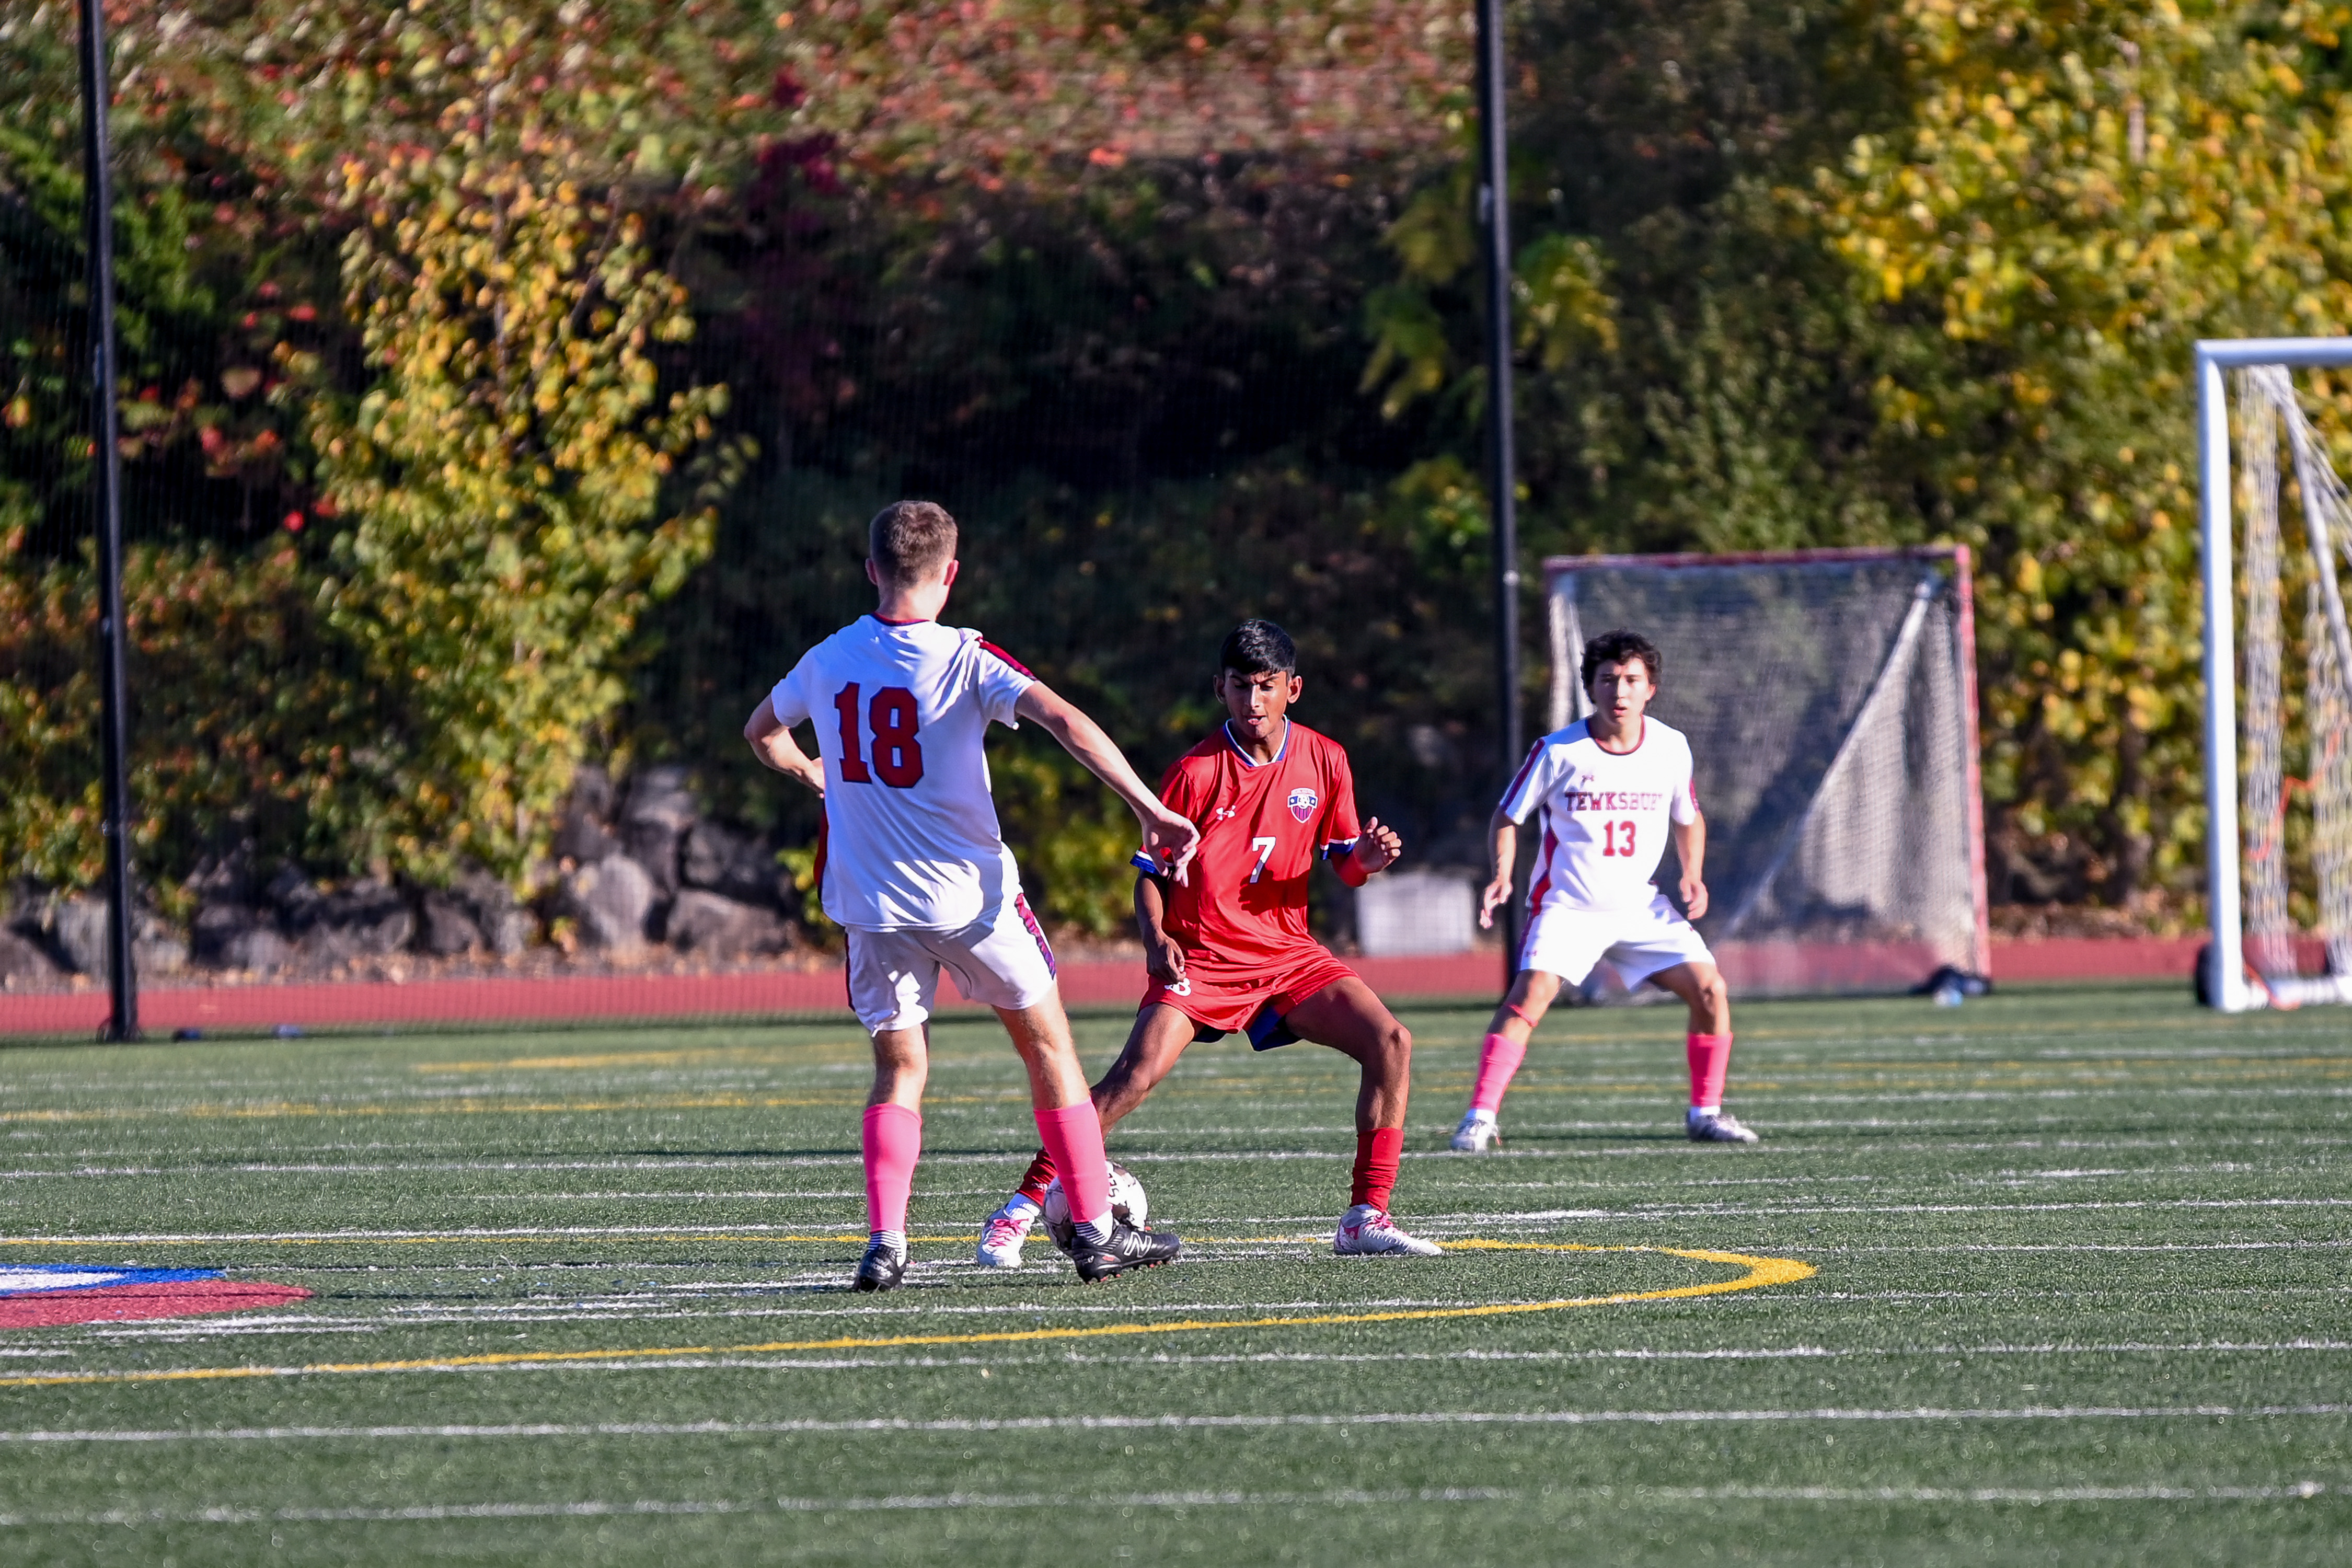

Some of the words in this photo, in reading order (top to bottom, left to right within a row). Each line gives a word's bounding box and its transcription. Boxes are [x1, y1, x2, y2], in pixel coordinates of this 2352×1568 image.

[834, 681, 924, 788] 18
[1250, 836, 1276, 883] 7
[1602, 820, 1636, 857] 13
